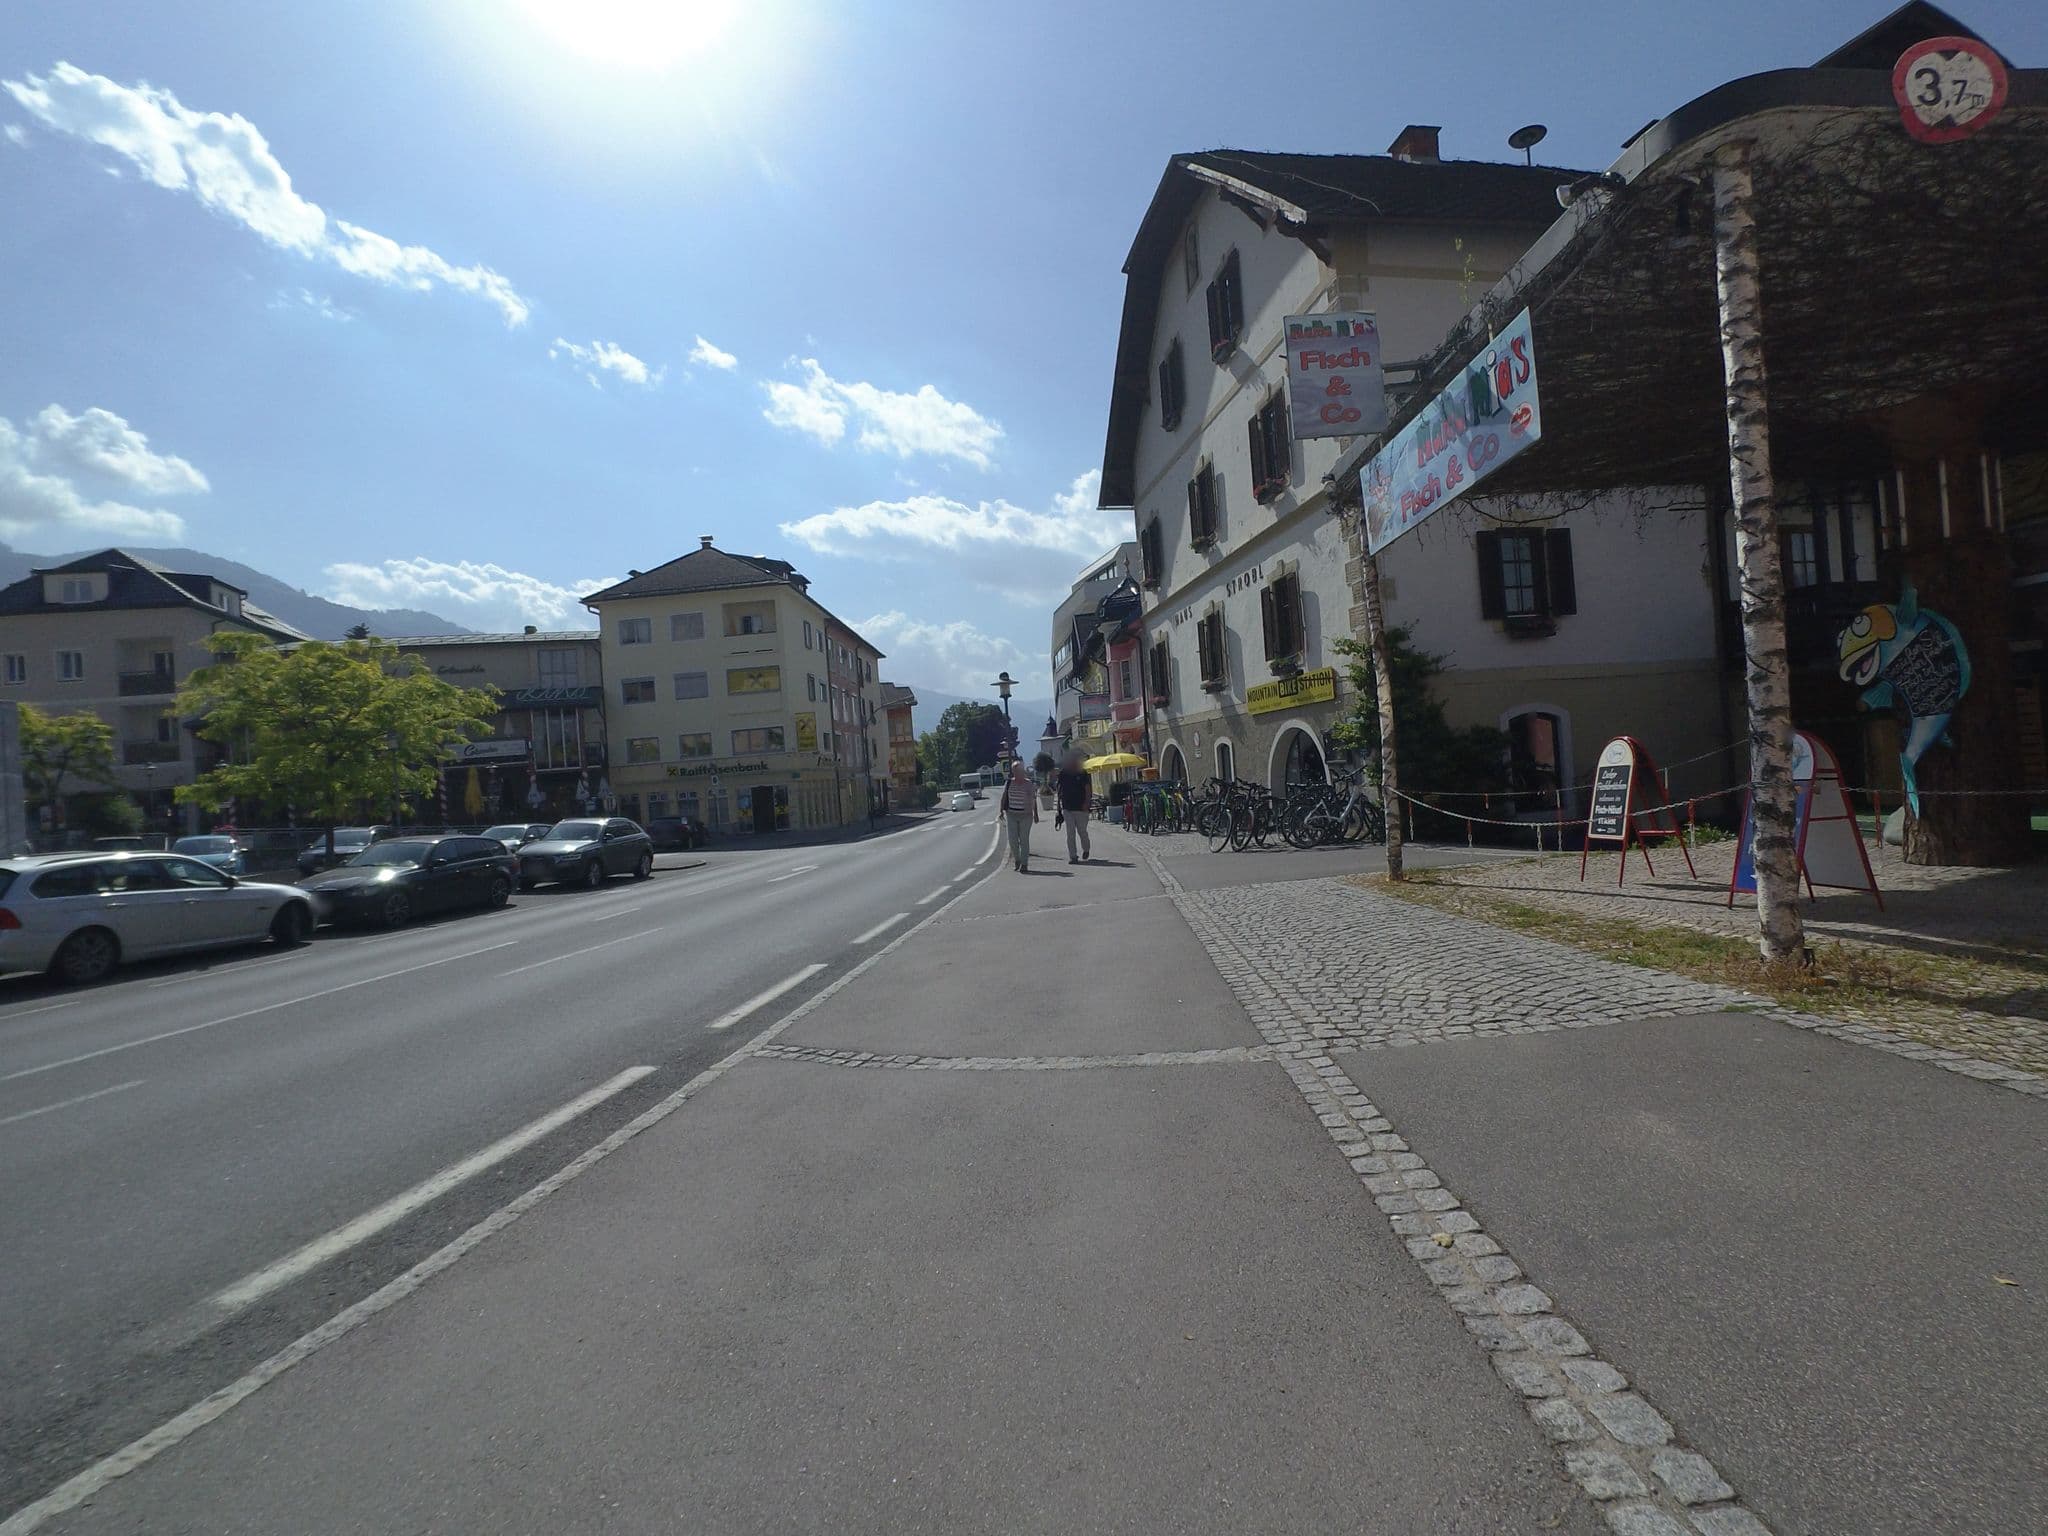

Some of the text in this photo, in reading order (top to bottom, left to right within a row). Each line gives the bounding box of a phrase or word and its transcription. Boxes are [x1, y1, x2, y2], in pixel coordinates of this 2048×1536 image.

[1299, 346, 1370, 371] Fisch
[1326, 375, 1352, 397] &
[1399, 472, 1443, 524] Fisch
[1445, 454, 1464, 490] &
[1225, 563, 1264, 598] STROBL
[1246, 670, 1332, 704] MOUNTAIN BIKE STATION
